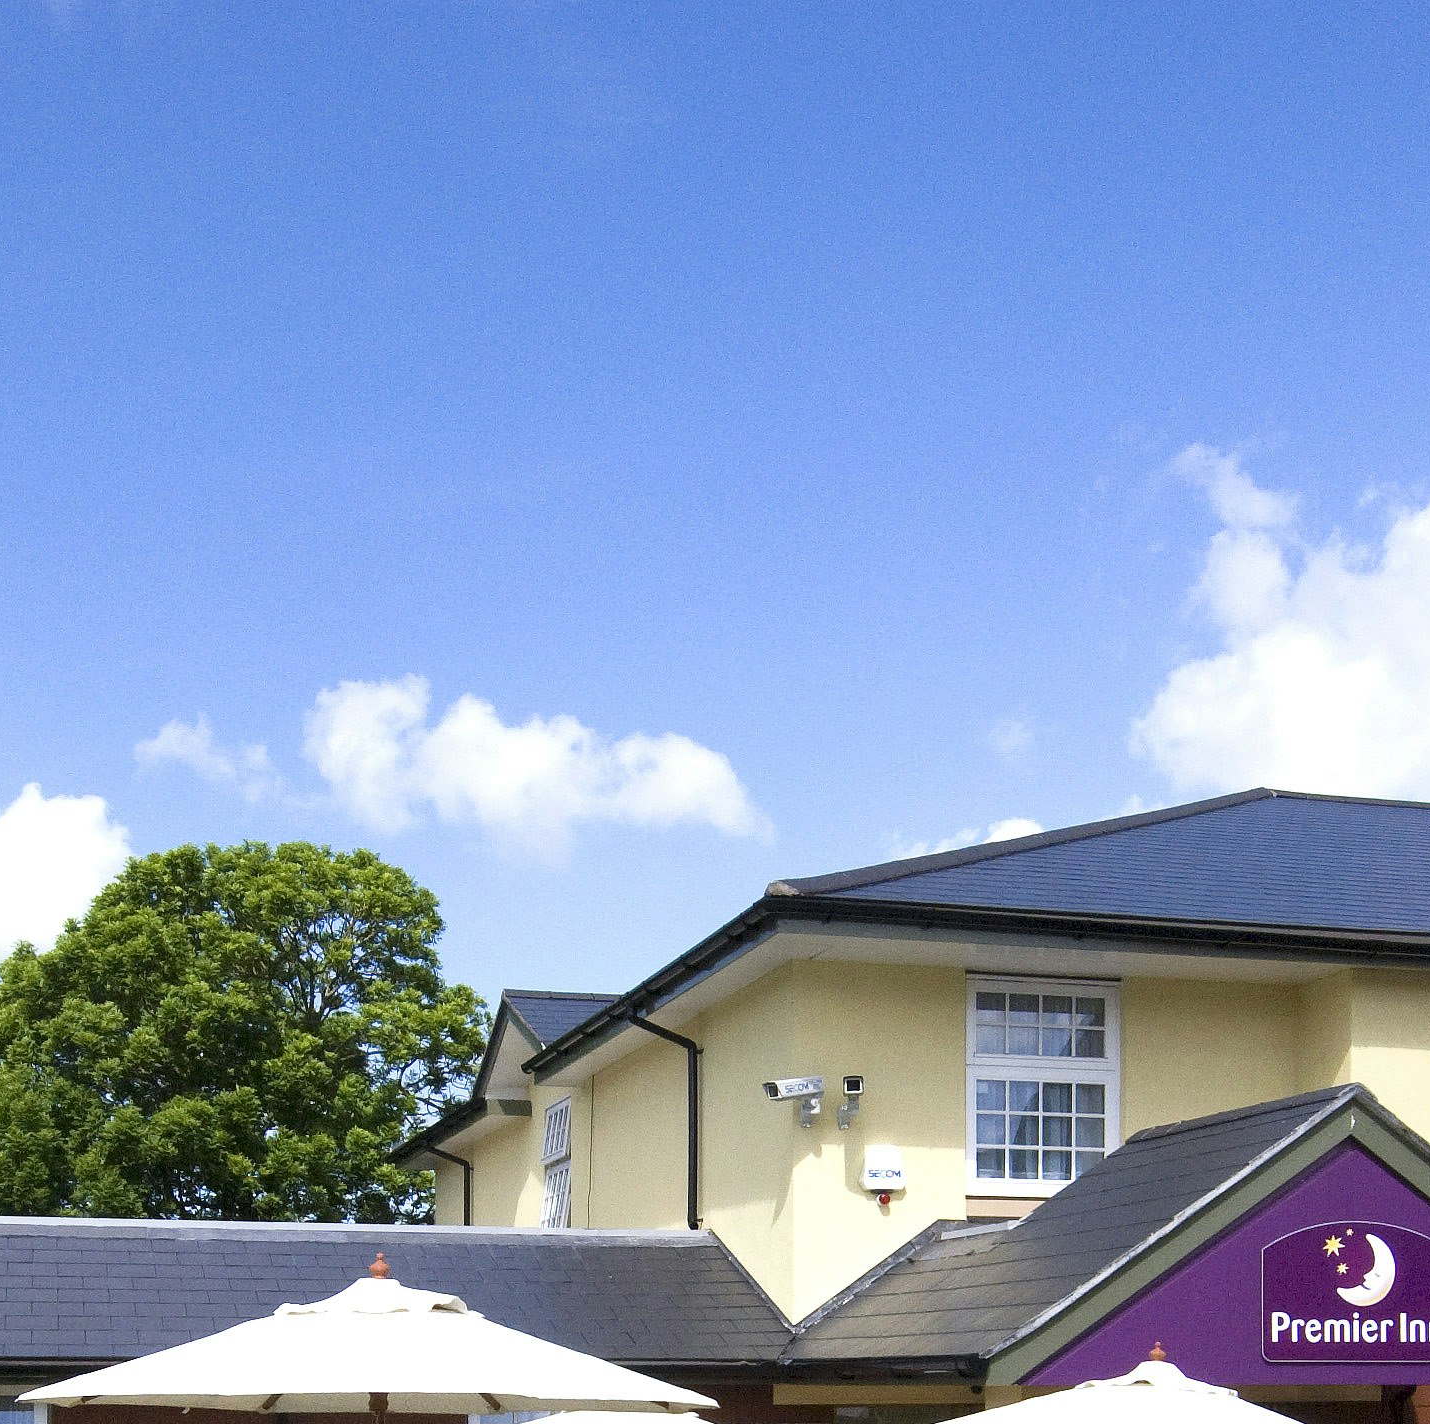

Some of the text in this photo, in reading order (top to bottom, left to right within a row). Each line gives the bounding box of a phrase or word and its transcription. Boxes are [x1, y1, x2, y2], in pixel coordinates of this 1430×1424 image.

[784, 1081, 810, 1094] SECOM
[868, 1169, 901, 1178] SECOM
[1271, 1311, 1394, 1344] Premier
